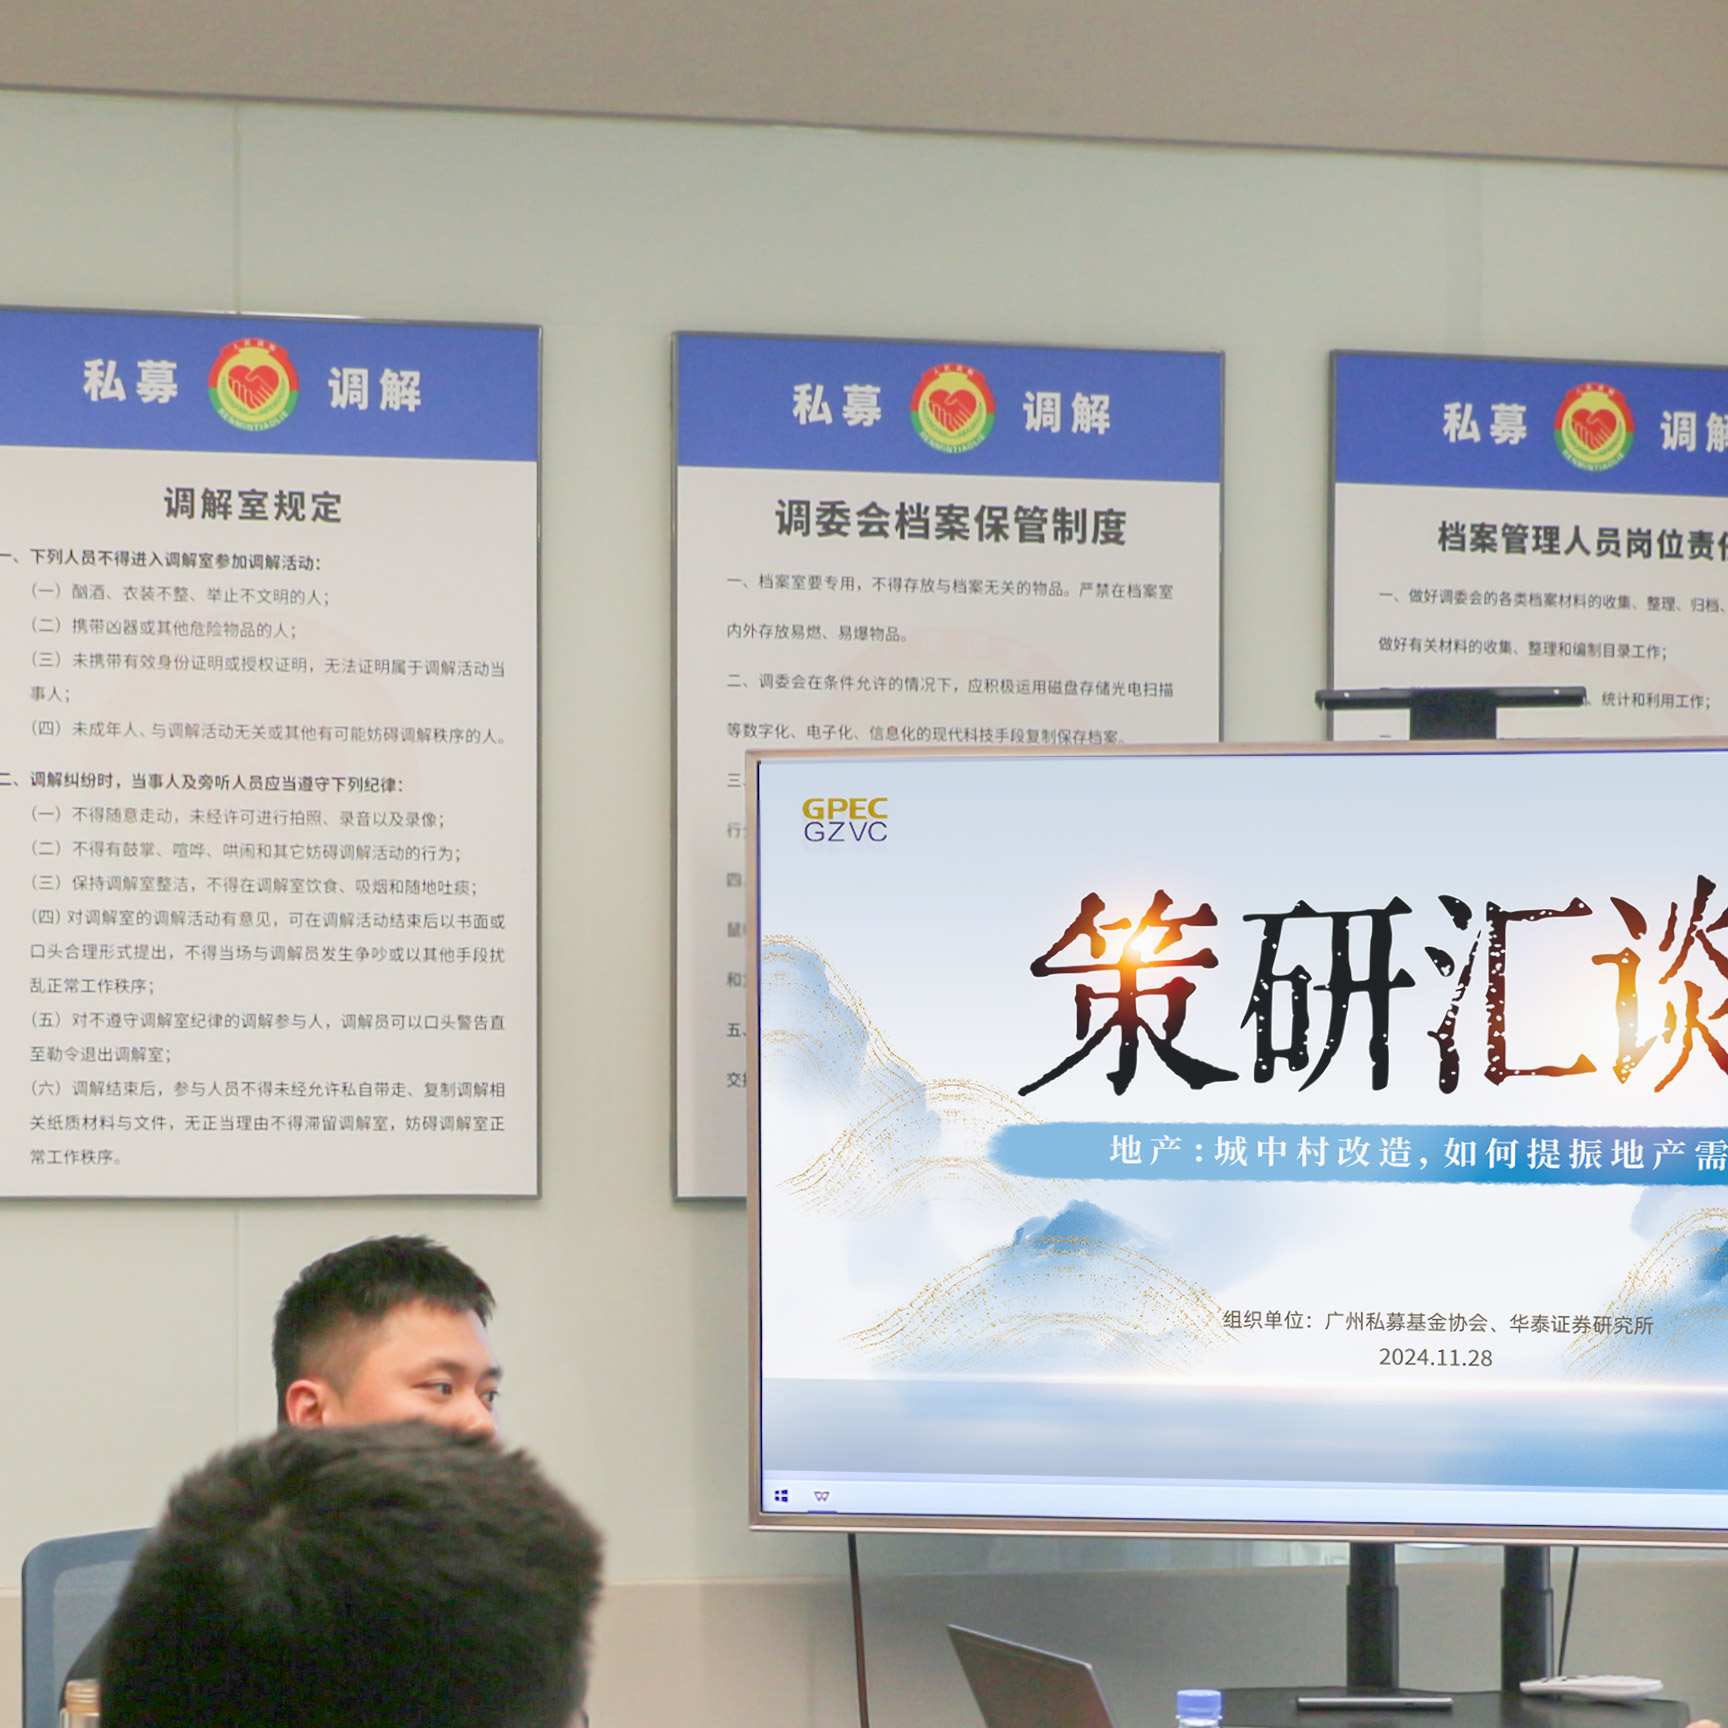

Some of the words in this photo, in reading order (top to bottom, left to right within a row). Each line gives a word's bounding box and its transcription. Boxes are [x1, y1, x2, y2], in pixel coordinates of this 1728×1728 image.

[83, 359, 179, 404] 私募
[328, 367, 422, 412] 调解
[792, 383, 883, 427] 私募
[1023, 391, 1112, 435] 调解
[1443, 401, 1528, 446] 私募
[164, 487, 341, 523] 调解室规定
[775, 500, 1126, 546] 调委会档案保管制度
[31, 686, 69, 702] 事人；
[802, 797, 888, 819] GPEC
[804, 821, 887, 842] GZVC
[31, 1149, 119, 1165] 常工作秩序。
[1378, 1347, 1493, 1368] 2024.11.28
